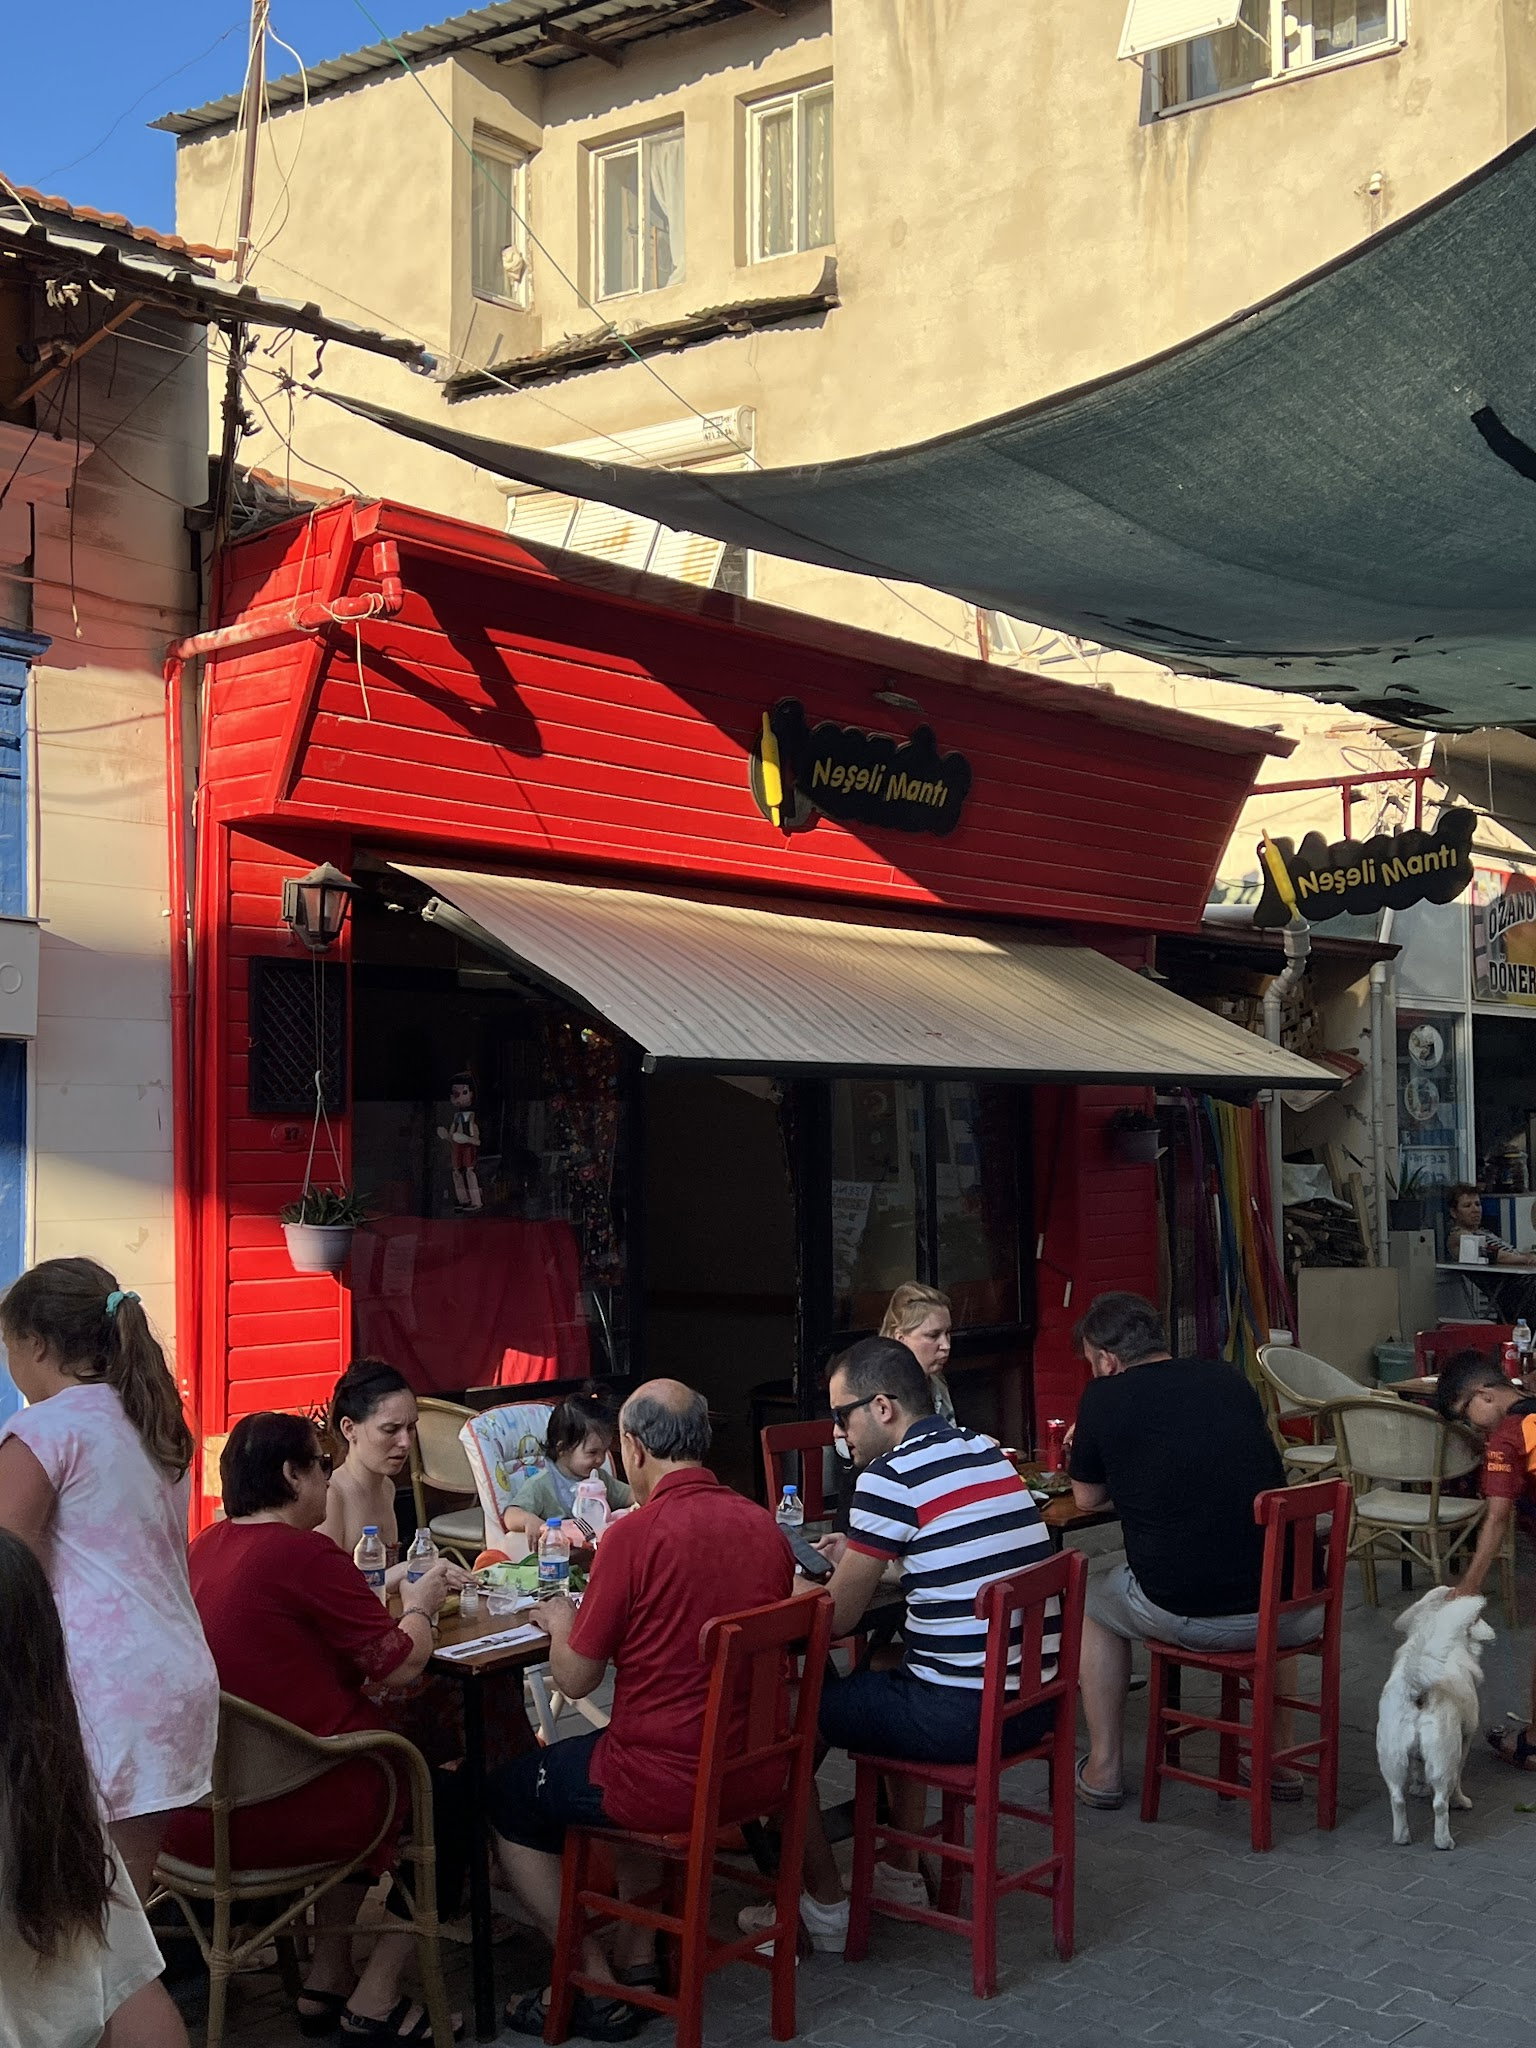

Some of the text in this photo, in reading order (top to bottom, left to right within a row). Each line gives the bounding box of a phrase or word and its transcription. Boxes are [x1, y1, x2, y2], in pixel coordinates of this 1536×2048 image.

[886, 772, 948, 807] Mantı
[1381, 844, 1457, 886] Mantı
[1489, 953, 1536, 994] DÖNER
